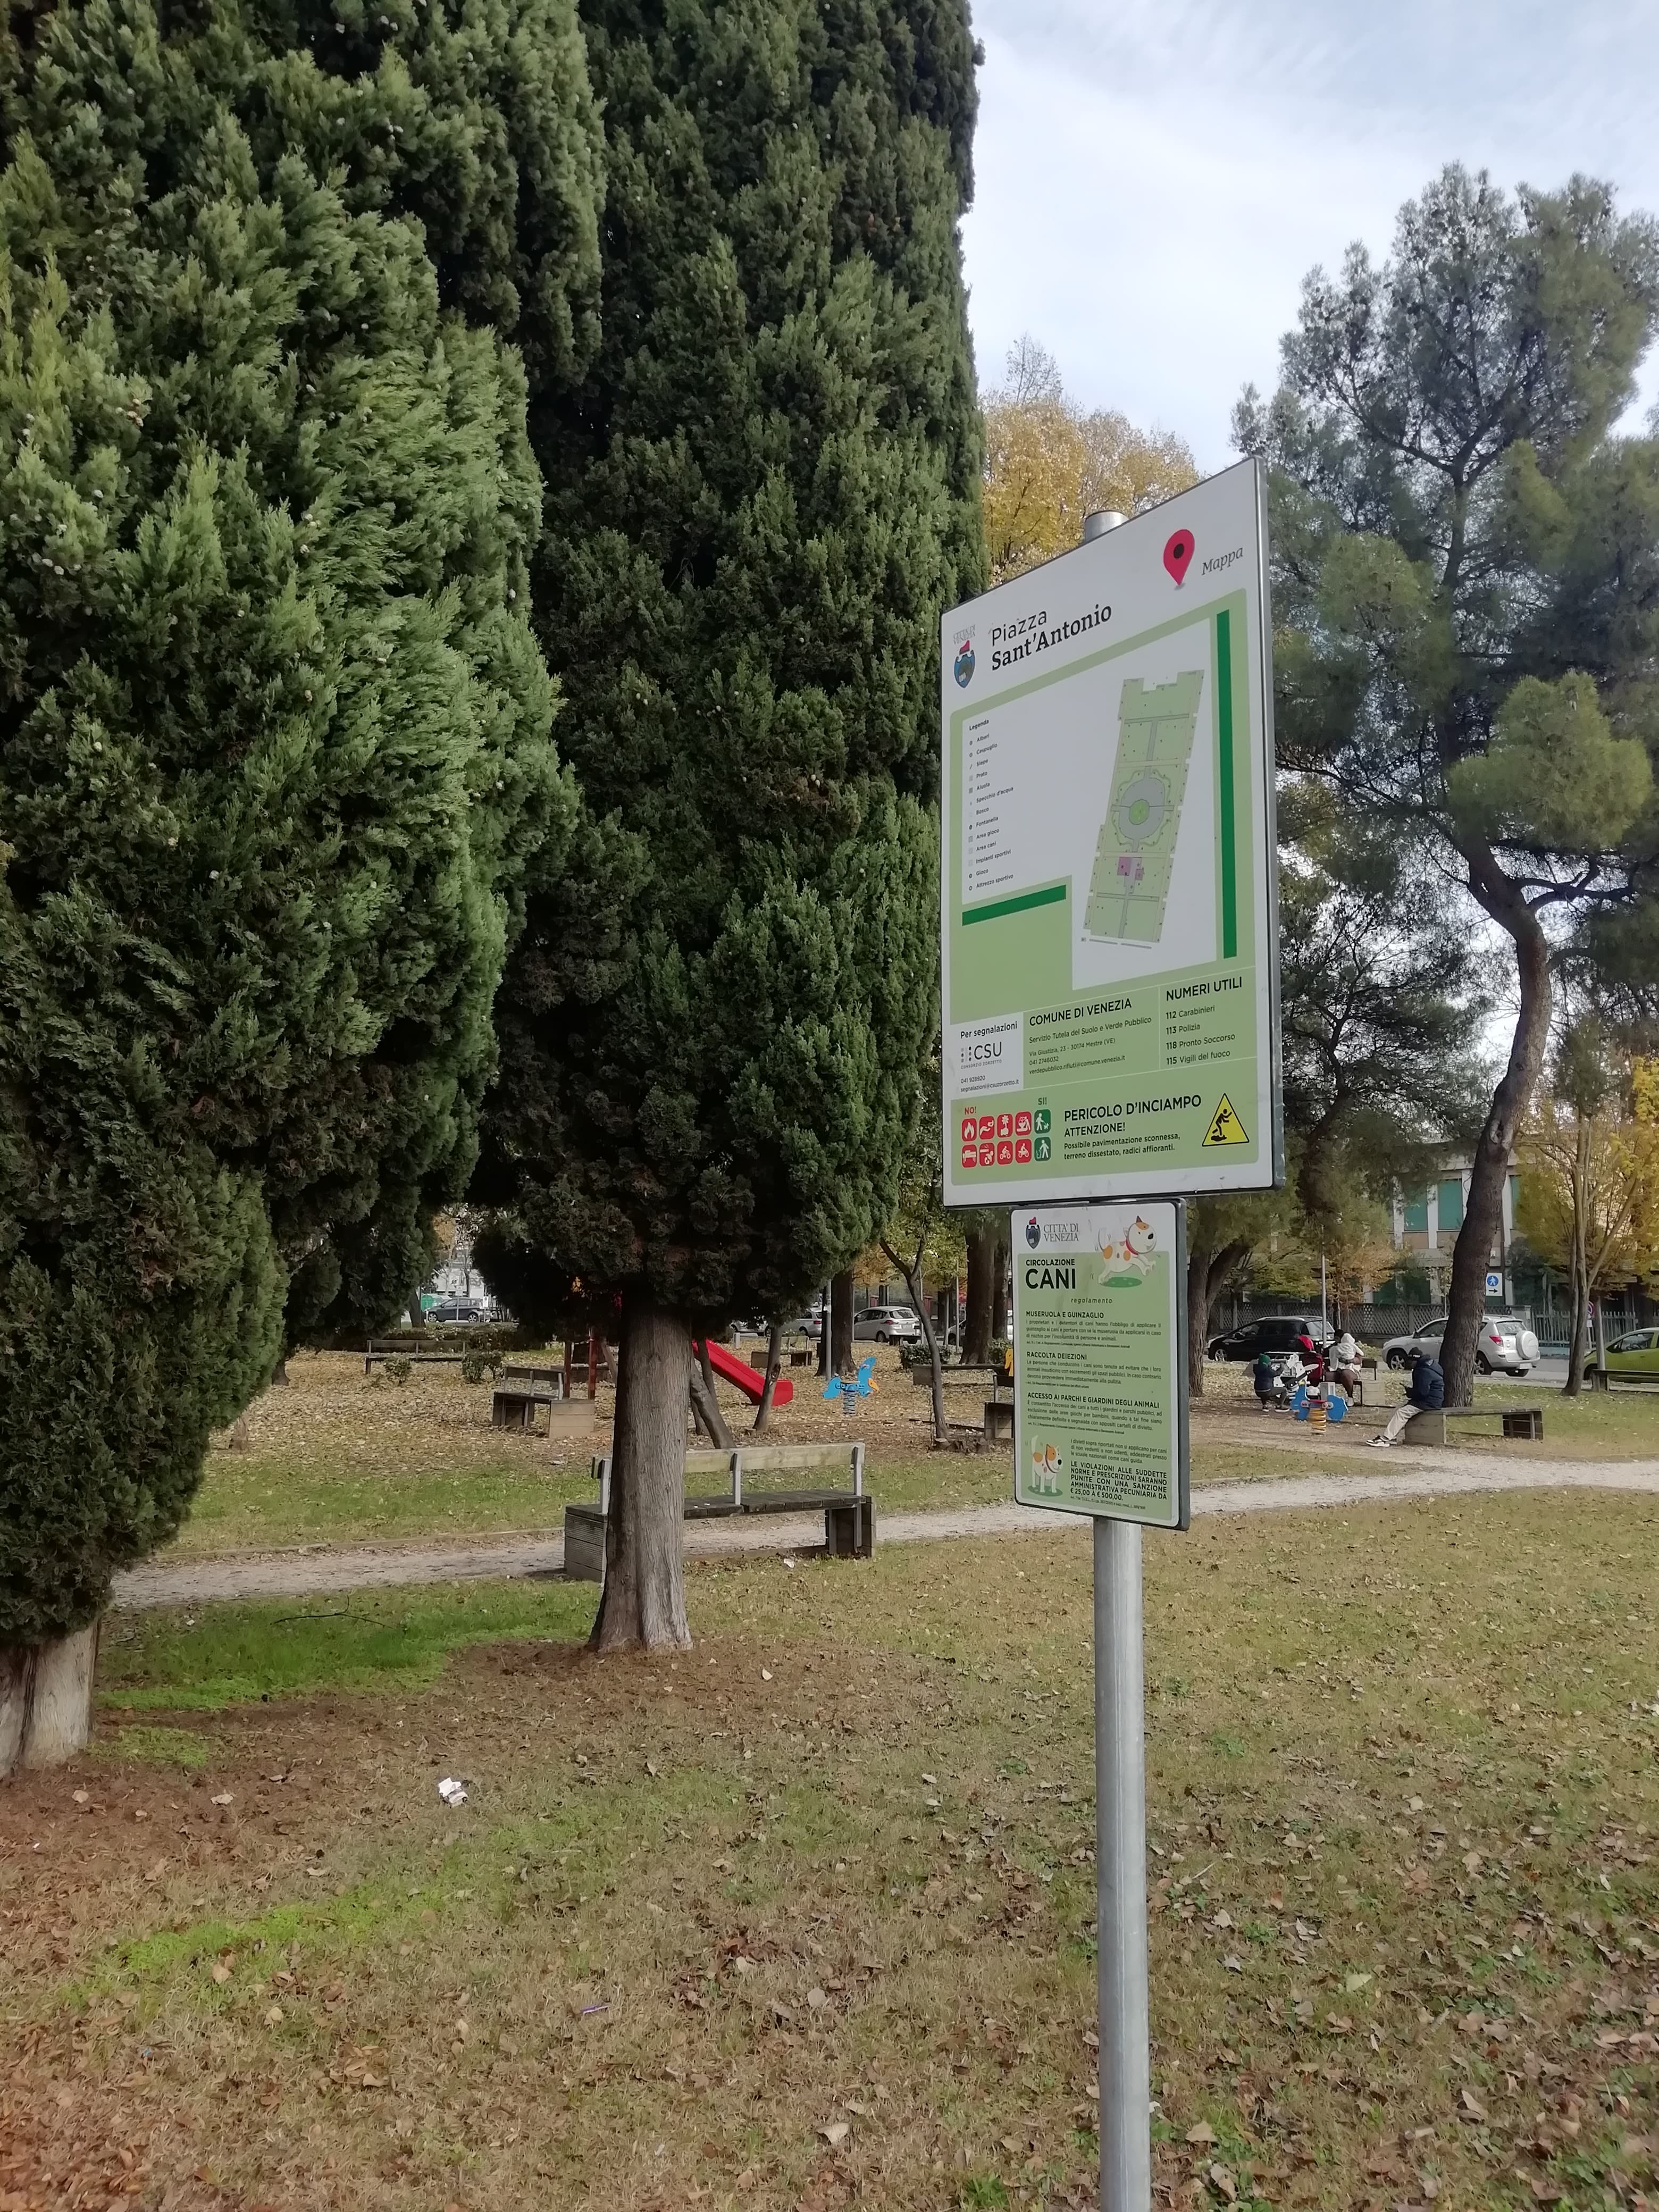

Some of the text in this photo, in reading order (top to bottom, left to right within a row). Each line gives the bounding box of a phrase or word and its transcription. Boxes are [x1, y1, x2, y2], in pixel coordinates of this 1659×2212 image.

[1202, 548, 1243, 575] Mappa
[993, 611, 1046, 647] Piazza
[992, 604, 1111, 671] Sant'Antonio
[969, 719, 989, 731] Legenda
[976, 786, 1014, 803] Specchio d'acqua
[976, 816, 999, 827] Fontanella
[987, 828, 1000, 837] gioco
[976, 849, 1011, 864] Impianti sportivi
[976, 874, 1013, 889] Attrezzo sportivo
[1166, 976, 1242, 1001] NUMERI UTILI
[1029, 998, 1132, 1026] COMUNE DI VENEZIA
[1166, 1005, 1215, 1020] 112 Carabinieri
[974, 1020, 1017, 1037] segnalazioni
[1029, 1034, 1051, 1044] Servizio
[1052, 1030, 1069, 1039] Tutela
[1070, 1028, 1080, 1036] del
[1081, 1026, 1099, 1035] Suolo
[1104, 1021, 1123, 1030] Verde
[1124, 1017, 1152, 1027] Pubblico
[1166, 1023, 1200, 1035] 113 Polizia
[1166, 1034, 1236, 1050] 118 Pronto Soccorso
[974, 1041, 1002, 1060] CSU
[1166, 1050, 1230, 1065] 115 Vigili del fuoco
[964, 1106, 977, 1115] NO!
[1065, 1094, 1202, 1122] PERICOLO D'INCIAMPO
[1064, 1122, 1125, 1137] ATTENZIONE!
[1064, 1133, 1180, 1150] Possibile pavimentazione sconnessa,
[1087, 1149, 1121, 1158] dissestato,
[1122, 1146, 1141, 1155] radici
[1142, 1143, 1175, 1153] affioranti.
[1043, 1223, 1079, 1233] CITTA' DI
[1043, 1233, 1079, 1242] VENEZIA
[1025, 1268, 1076, 1289] CANI
[1134, 1400, 1159, 1409] ANIMALI
[1070, 1467, 1090, 1476] NORME
[1096, 1471, 1136, 1482] PRESCRIZIONI
[1138, 1476, 1167, 1486] SARANNO
[1080, 1462, 1115, 1472] VIOLAZIONI
[1135, 1469, 1167, 1479] SUDDETTE
[1070, 1481, 1119, 1494] AMMINISTRATIVA
[1120, 1487, 1157, 1498] PECUNIARIA
[1071, 1474, 1093, 1483] PUNITE
[1133, 1482, 1167, 1493] SANZIONE
[1101, 1492, 1124, 1501] 500,00.
